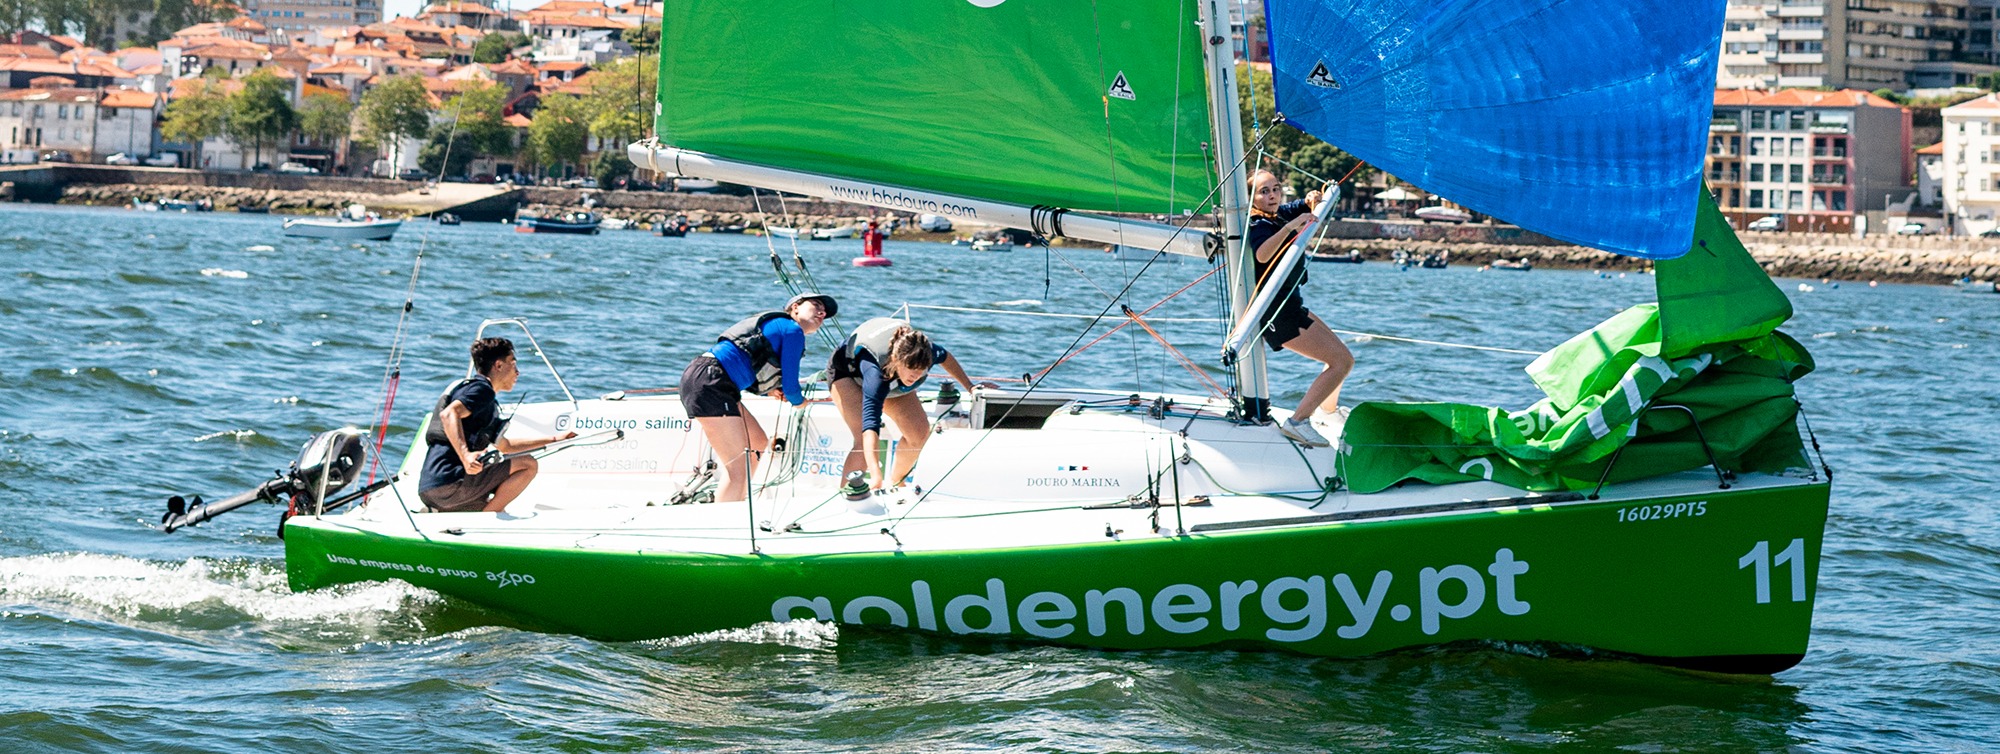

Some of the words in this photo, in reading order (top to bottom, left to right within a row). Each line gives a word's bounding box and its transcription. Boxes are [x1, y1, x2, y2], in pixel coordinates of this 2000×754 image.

[830, 185, 978, 219] www.bbdouro.com
[800, 461, 844, 476] GOALS
[1027, 478, 1068, 487] DOURO
[1071, 478, 1120, 487] MARINA
[1617, 501, 1707, 522] 16029PT5
[326, 553, 357, 566] Uma
[359, 558, 414, 572] empresa
[417, 564, 435, 574] do
[438, 567, 478, 579] grupo
[1738, 538, 1806, 604] 11
